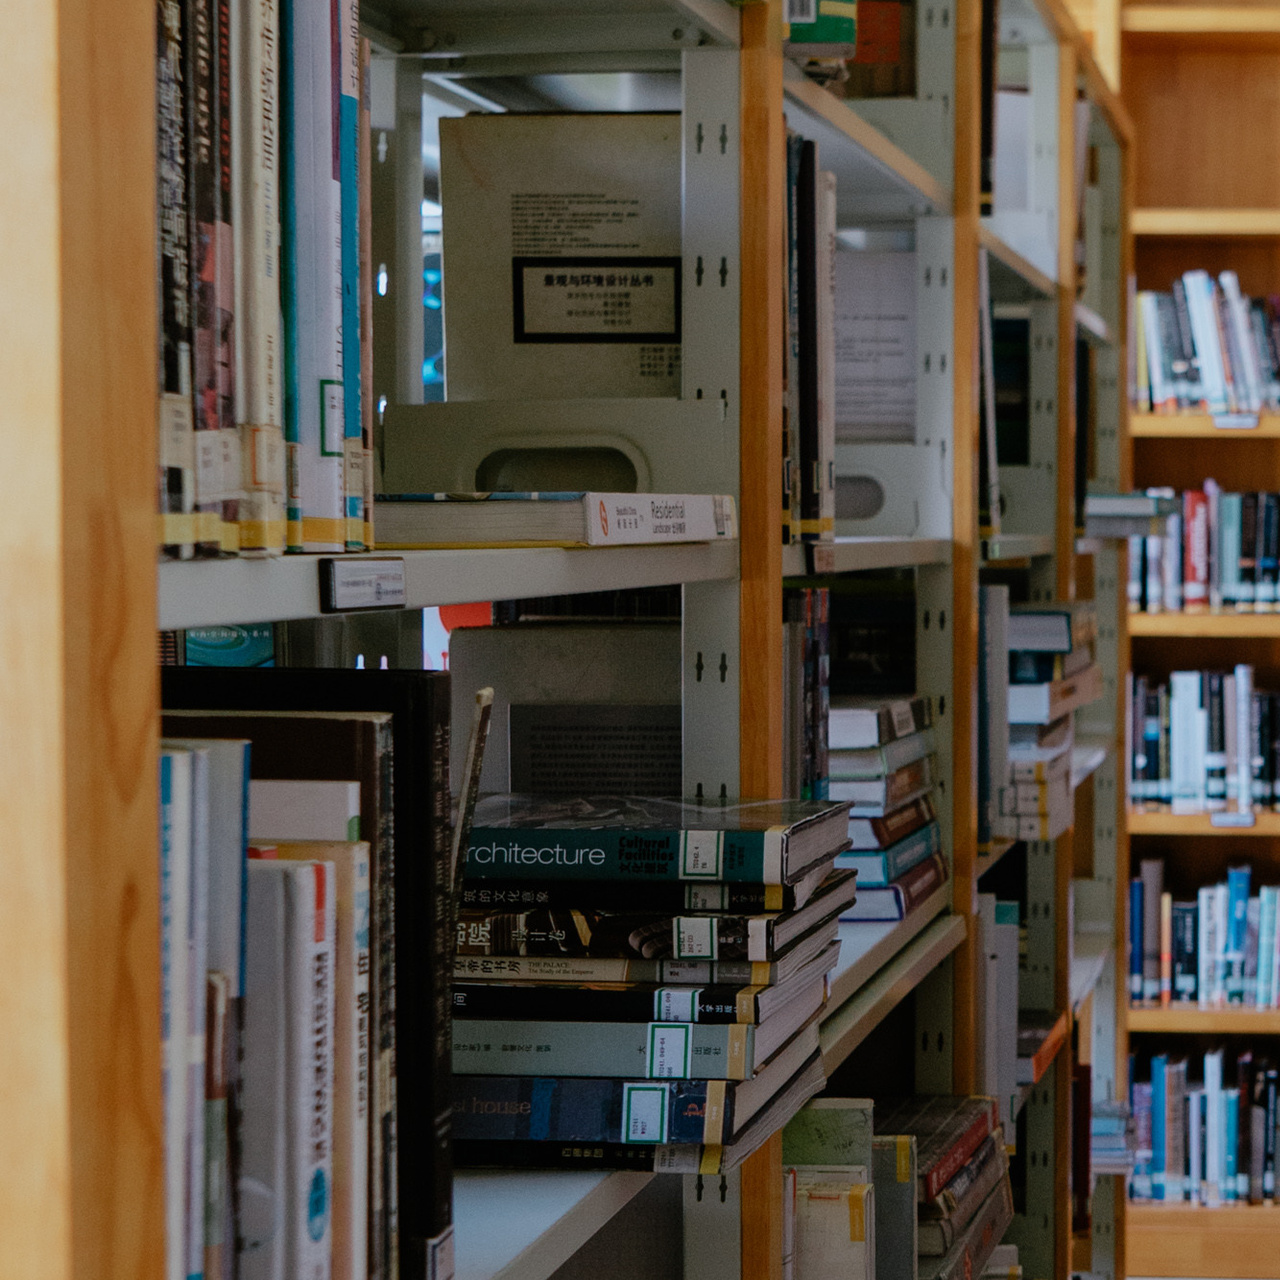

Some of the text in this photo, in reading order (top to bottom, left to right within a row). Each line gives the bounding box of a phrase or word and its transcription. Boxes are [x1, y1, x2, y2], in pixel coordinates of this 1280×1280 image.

[618, 835, 670, 849] Cultural
[465, 841, 606, 866] rchitecture
[618, 848, 674, 862] Facilities
[463, 889, 549, 903] 筑的文化意象
[472, 1096, 531, 1115] house
